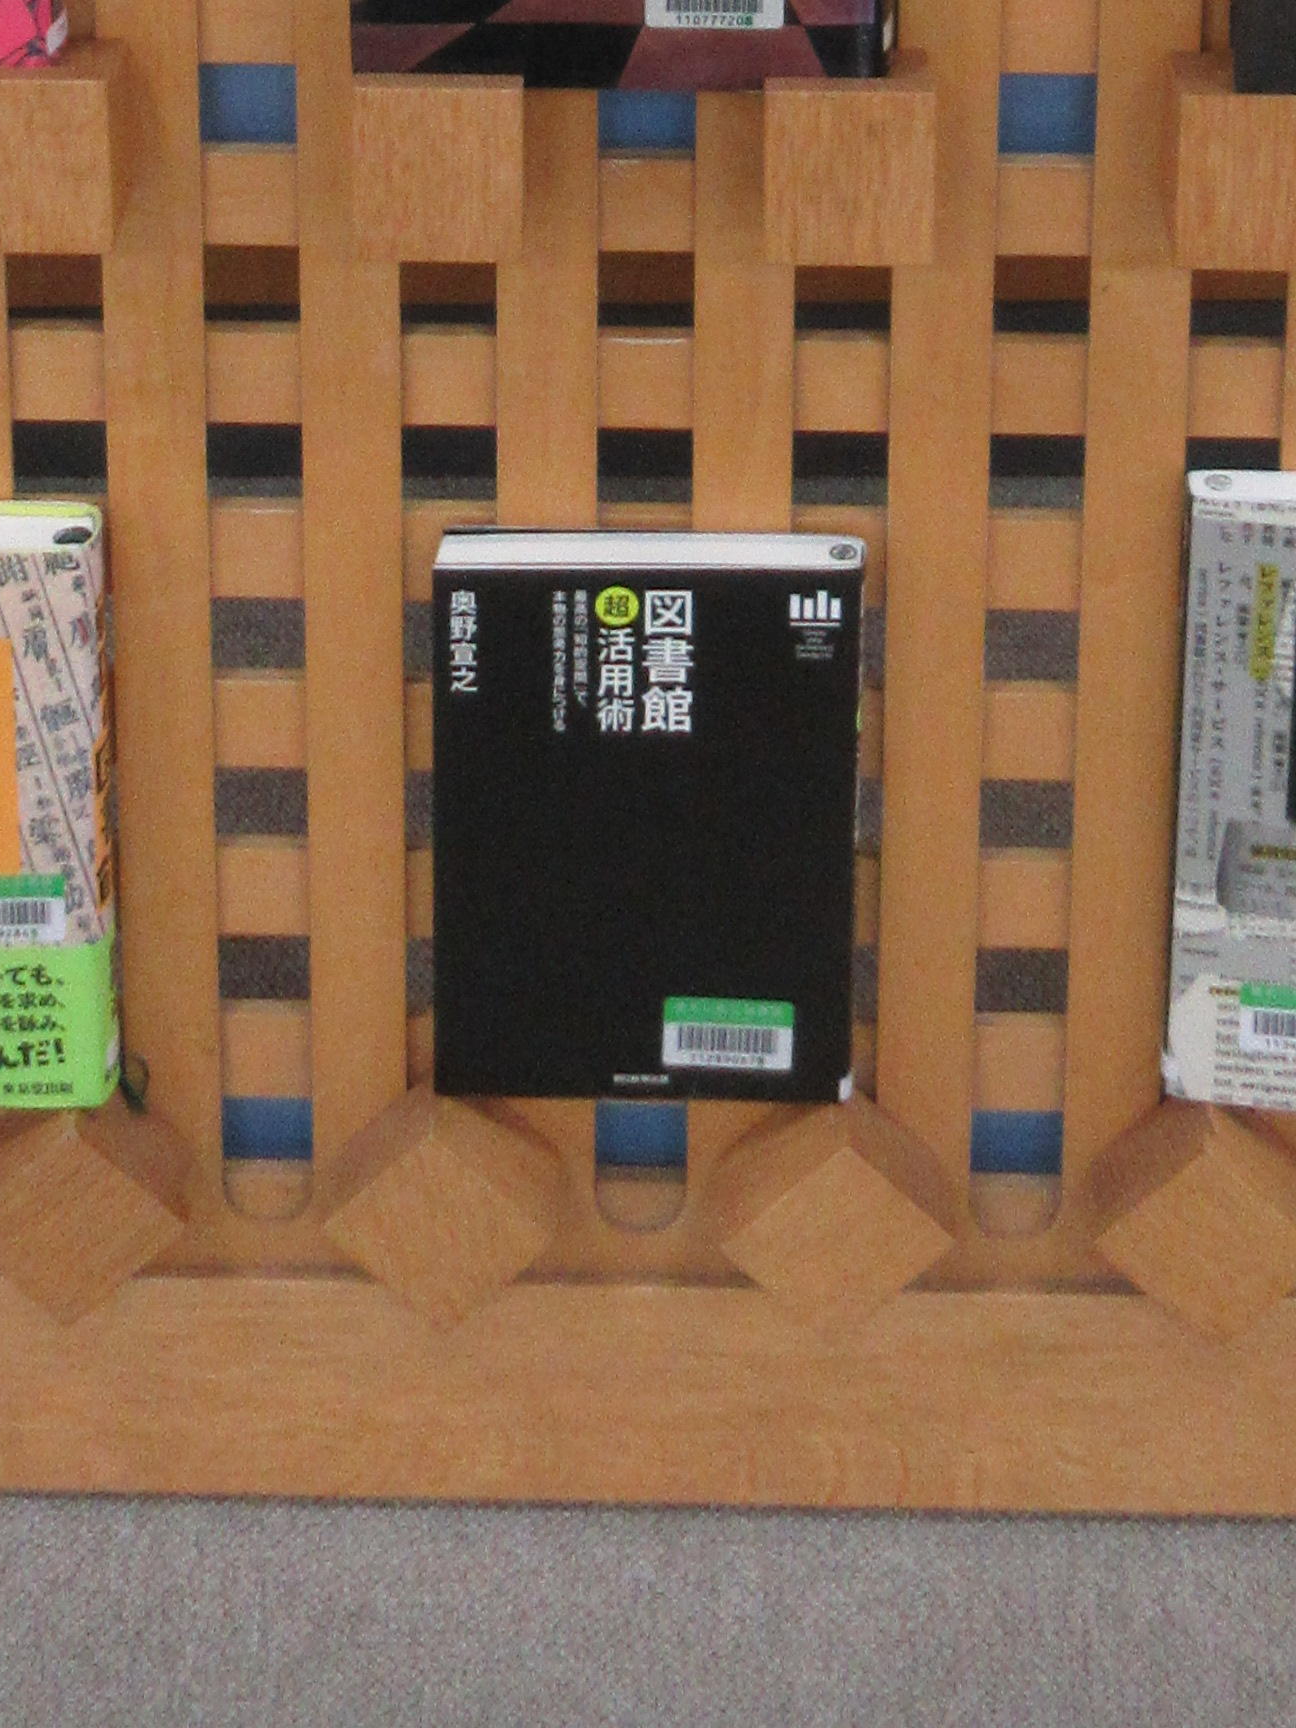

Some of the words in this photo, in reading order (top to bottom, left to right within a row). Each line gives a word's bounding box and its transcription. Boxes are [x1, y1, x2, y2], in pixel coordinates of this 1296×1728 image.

[450, 589, 478, 693] 奥野宣之
[597, 595, 635, 732] 超活用術
[642, 590, 694, 733] 図書館
